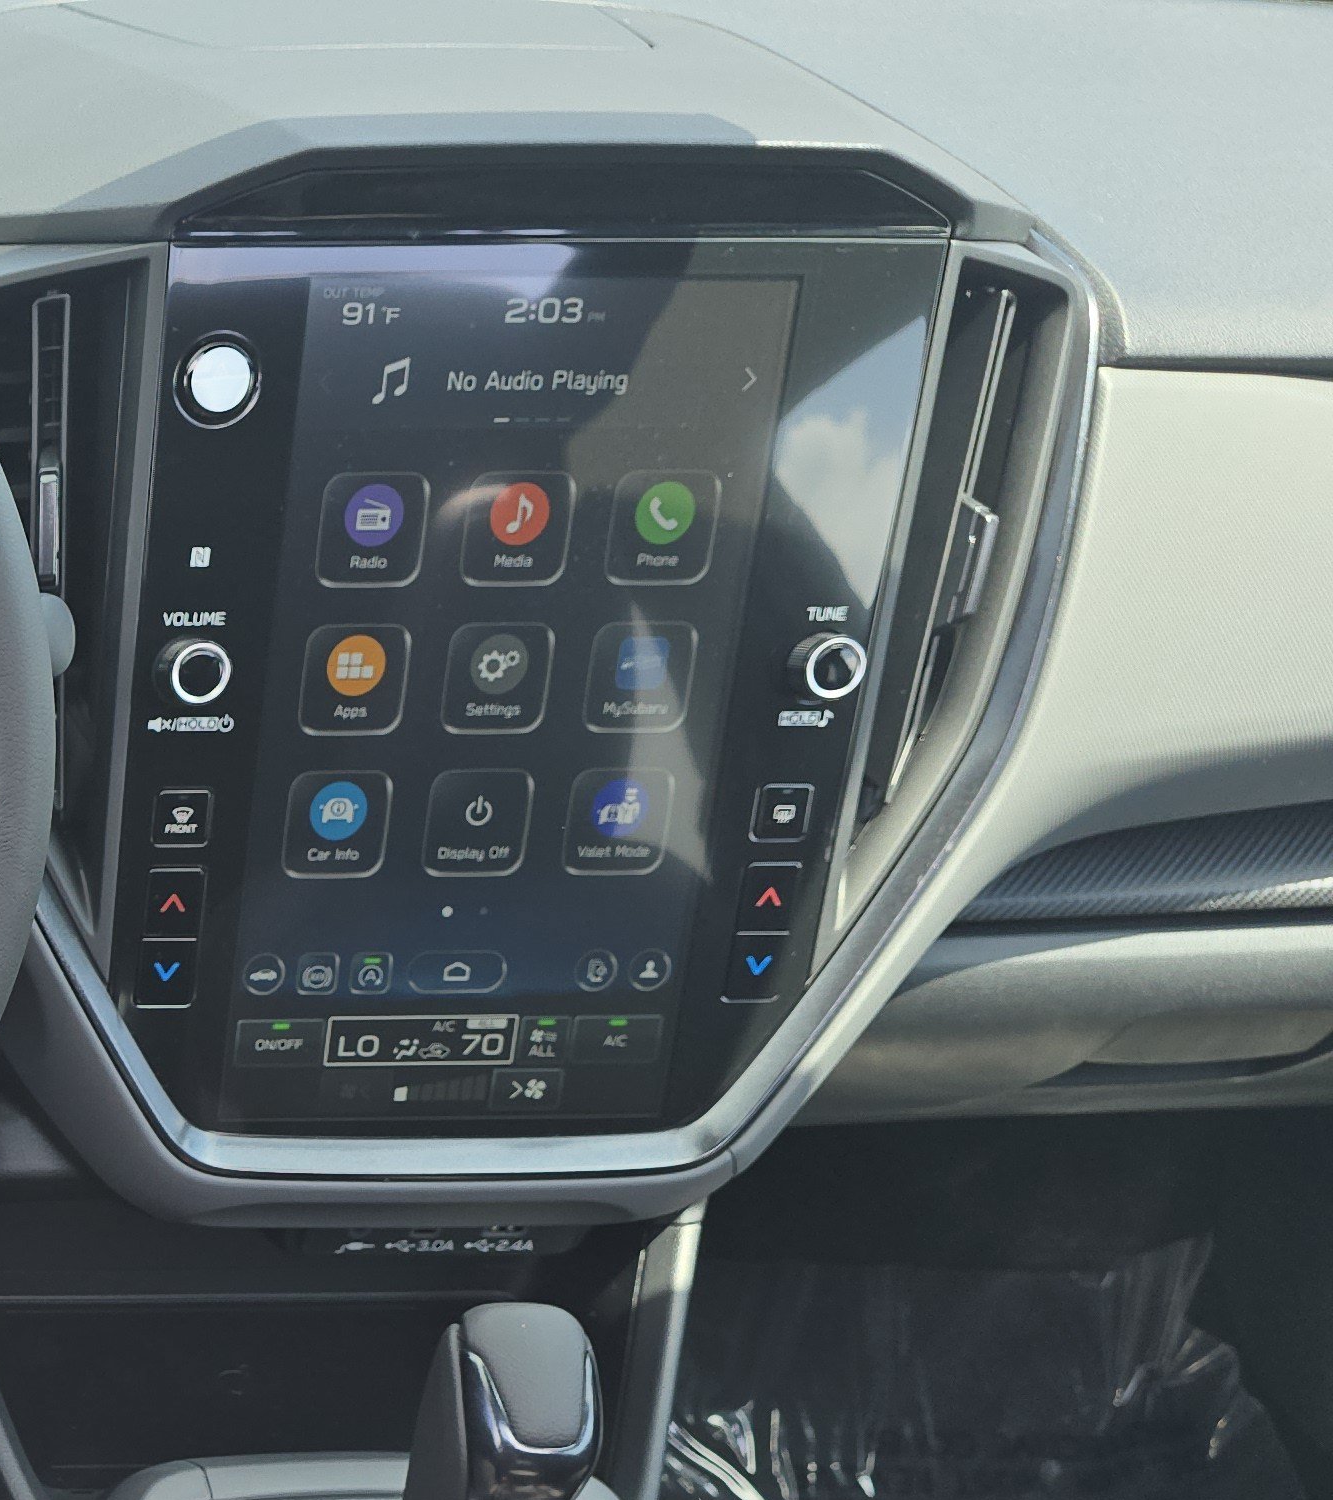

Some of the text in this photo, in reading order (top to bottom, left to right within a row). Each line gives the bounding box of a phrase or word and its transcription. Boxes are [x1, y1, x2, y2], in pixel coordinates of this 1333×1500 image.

[504, 297, 584, 324] 2:03
[446, 369, 629, 396] No Audio Playing
[349, 555, 388, 569] Radio
[493, 554, 533, 568] Media
[636, 553, 679, 567] Phone
[163, 611, 226, 627] VOLUME
[807, 605, 849, 621] TUNE
[334, 704, 367, 720] Apps
[465, 702, 521, 719] Settings
[307, 847, 360, 862] Car Info
[437, 845, 511, 863] Display Off
[577, 845, 651, 859] Valet Mode
[432, 1020, 457, 1033] A/C
[337, 1034, 380, 1058] LO
[460, 1034, 505, 1056] 70
[602, 1034, 628, 1048] A/C
[528, 1044, 557, 1058] ALL
